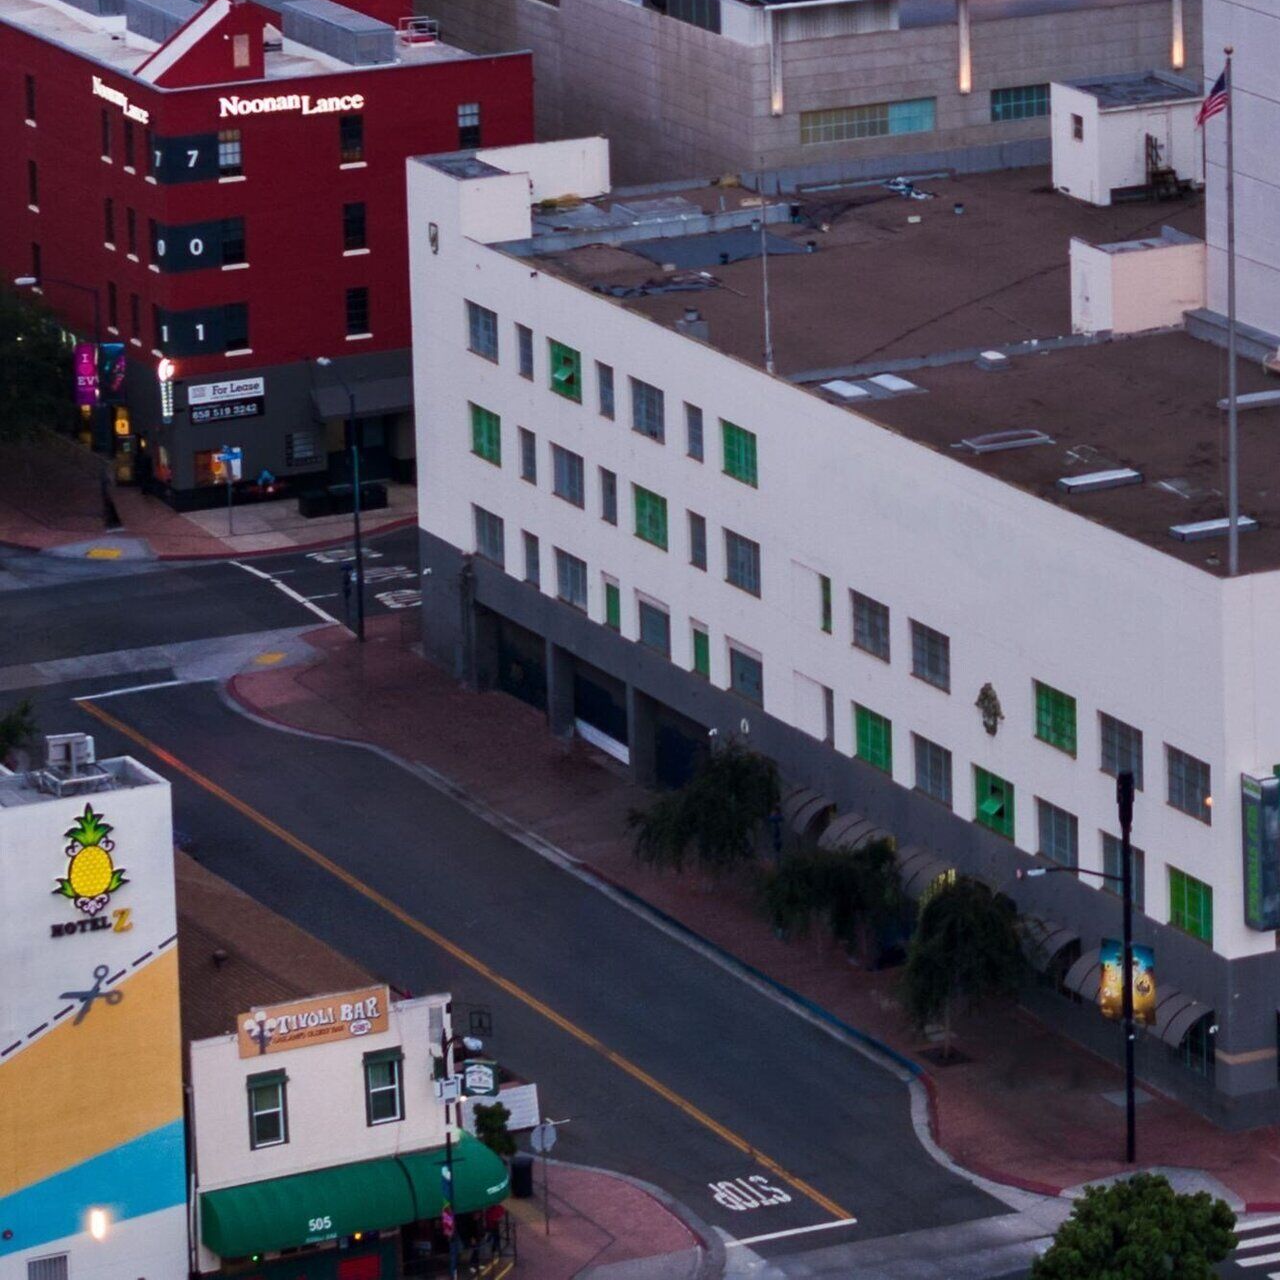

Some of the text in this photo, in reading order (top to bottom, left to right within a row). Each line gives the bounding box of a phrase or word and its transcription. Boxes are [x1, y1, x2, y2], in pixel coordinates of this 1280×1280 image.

[219, 93, 364, 117] Noonan Lance
[187, 149, 199, 167] 7
[189, 238, 204, 256] 0
[196, 323, 204, 341] 1
[212, 385, 228, 396] For
[230, 382, 260, 394] Lease
[51, 907, 133, 938] HOTEL Z
[276, 996, 381, 1034] TIVOLI BAR
[708, 1175, 791, 1211] STOP
[308, 1216, 332, 1231] 505
